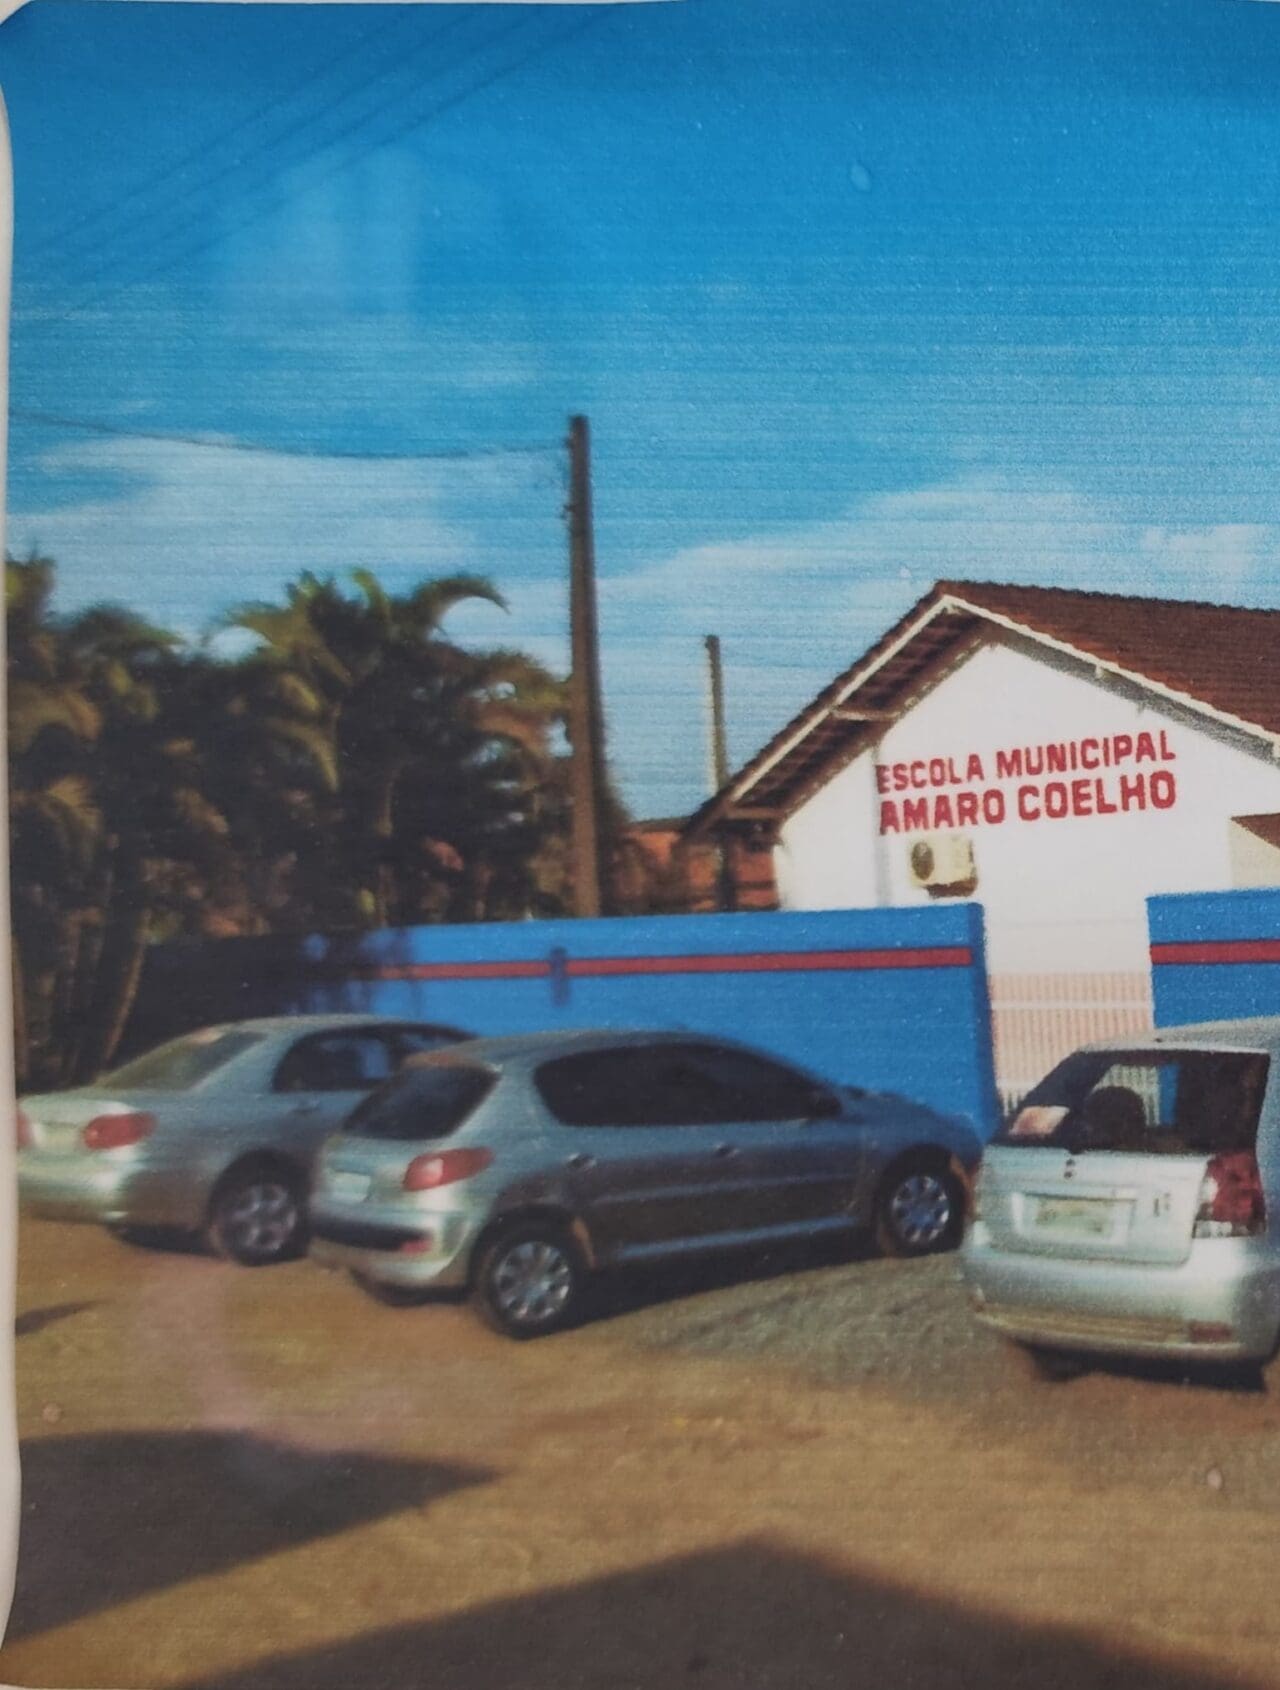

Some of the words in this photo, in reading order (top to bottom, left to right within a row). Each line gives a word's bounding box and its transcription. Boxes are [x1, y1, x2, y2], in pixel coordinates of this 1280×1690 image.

[875, 754, 984, 794] ESCOLA
[996, 730, 1176, 779] MUNICIPAL
[880, 788, 1006, 835] AMARO
[1018, 770, 1176, 821] COELHO
